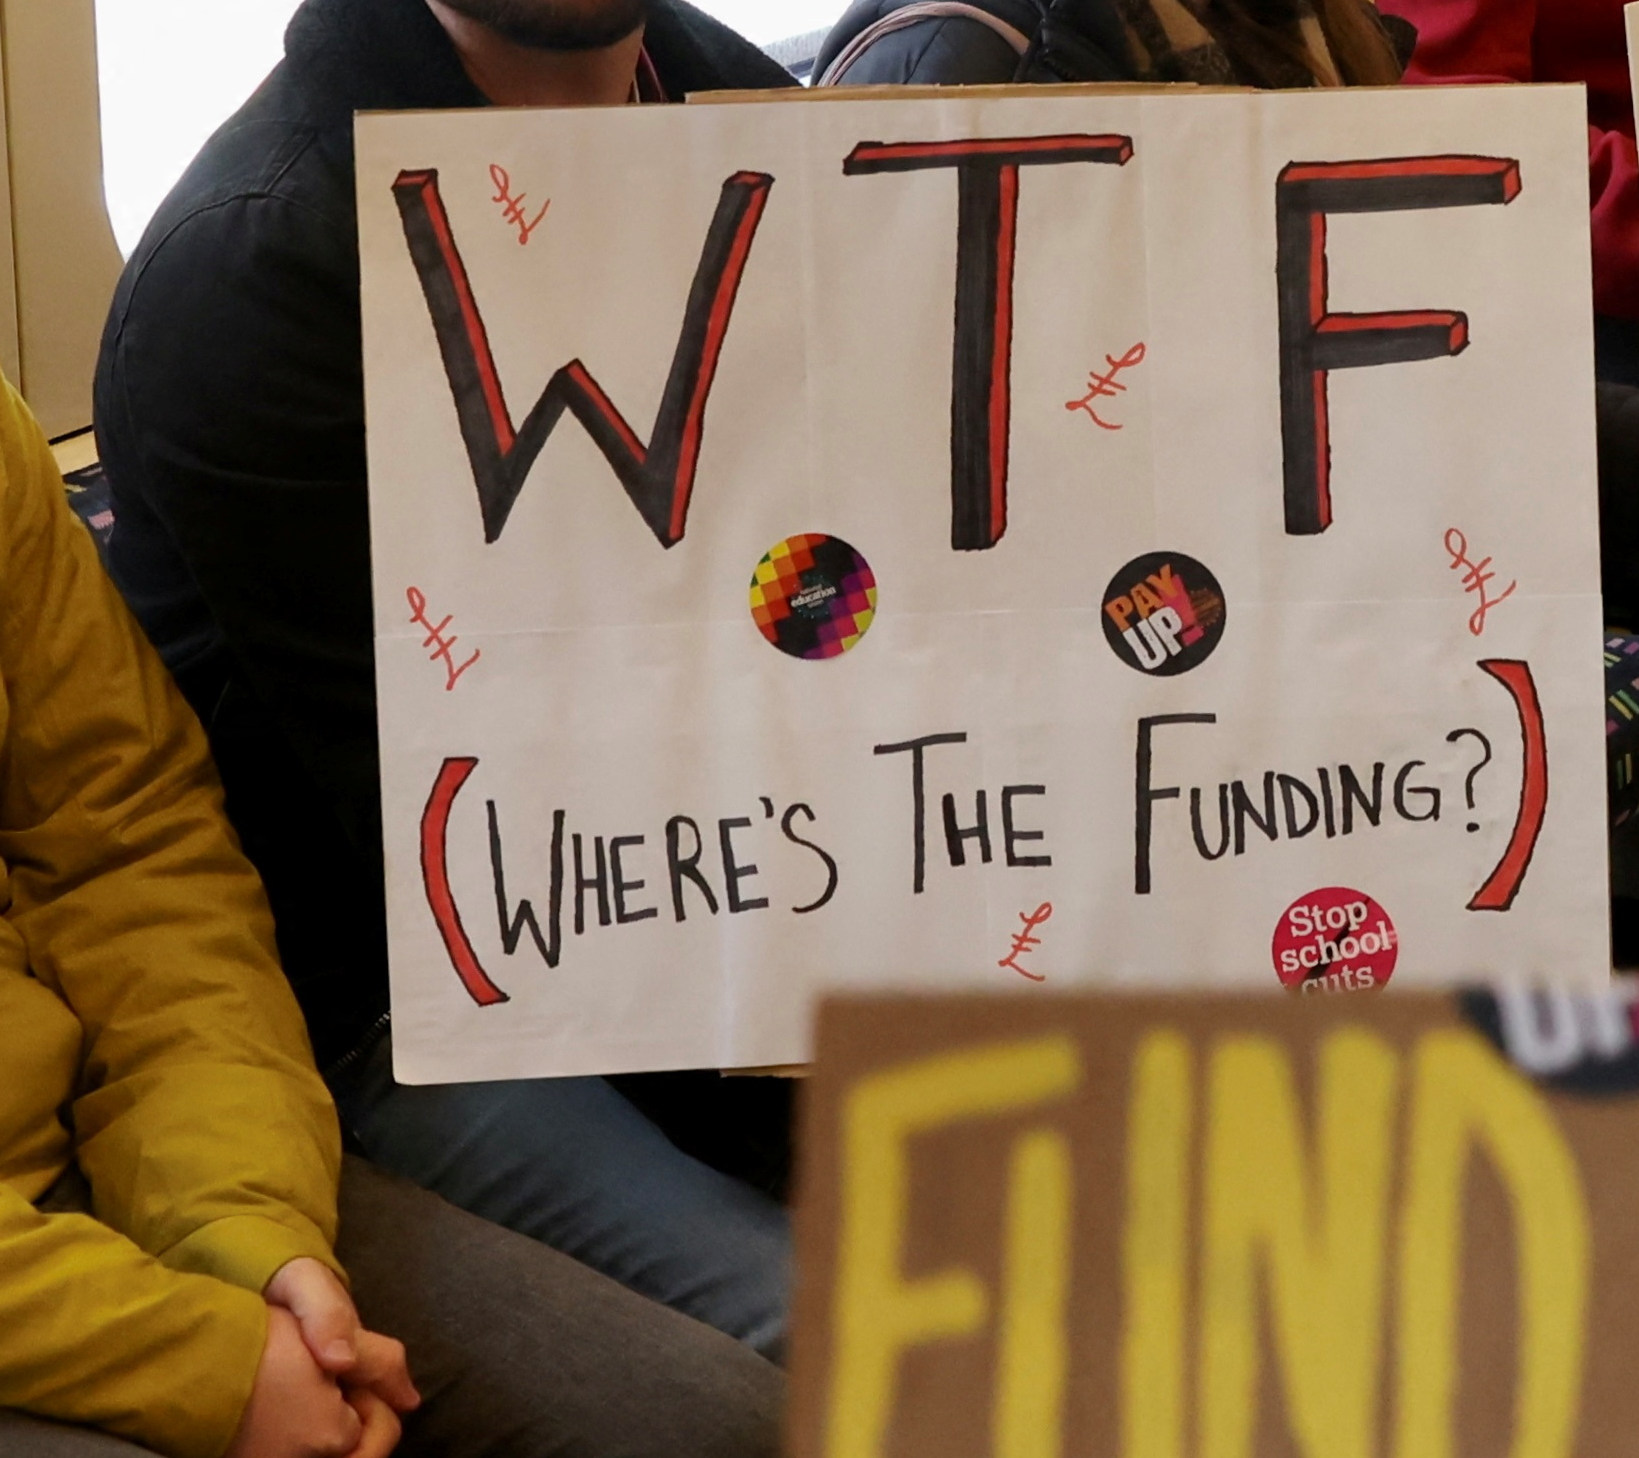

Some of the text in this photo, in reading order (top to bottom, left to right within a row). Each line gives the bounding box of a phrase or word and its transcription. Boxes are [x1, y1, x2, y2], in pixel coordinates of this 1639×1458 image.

[1105, 563, 1178, 632] PAY
[1122, 574, 1205, 670] UP!
[874, 731, 1052, 895] THE
[1280, 920, 1392, 973] school
[1289, 900, 1368, 938] Stop
